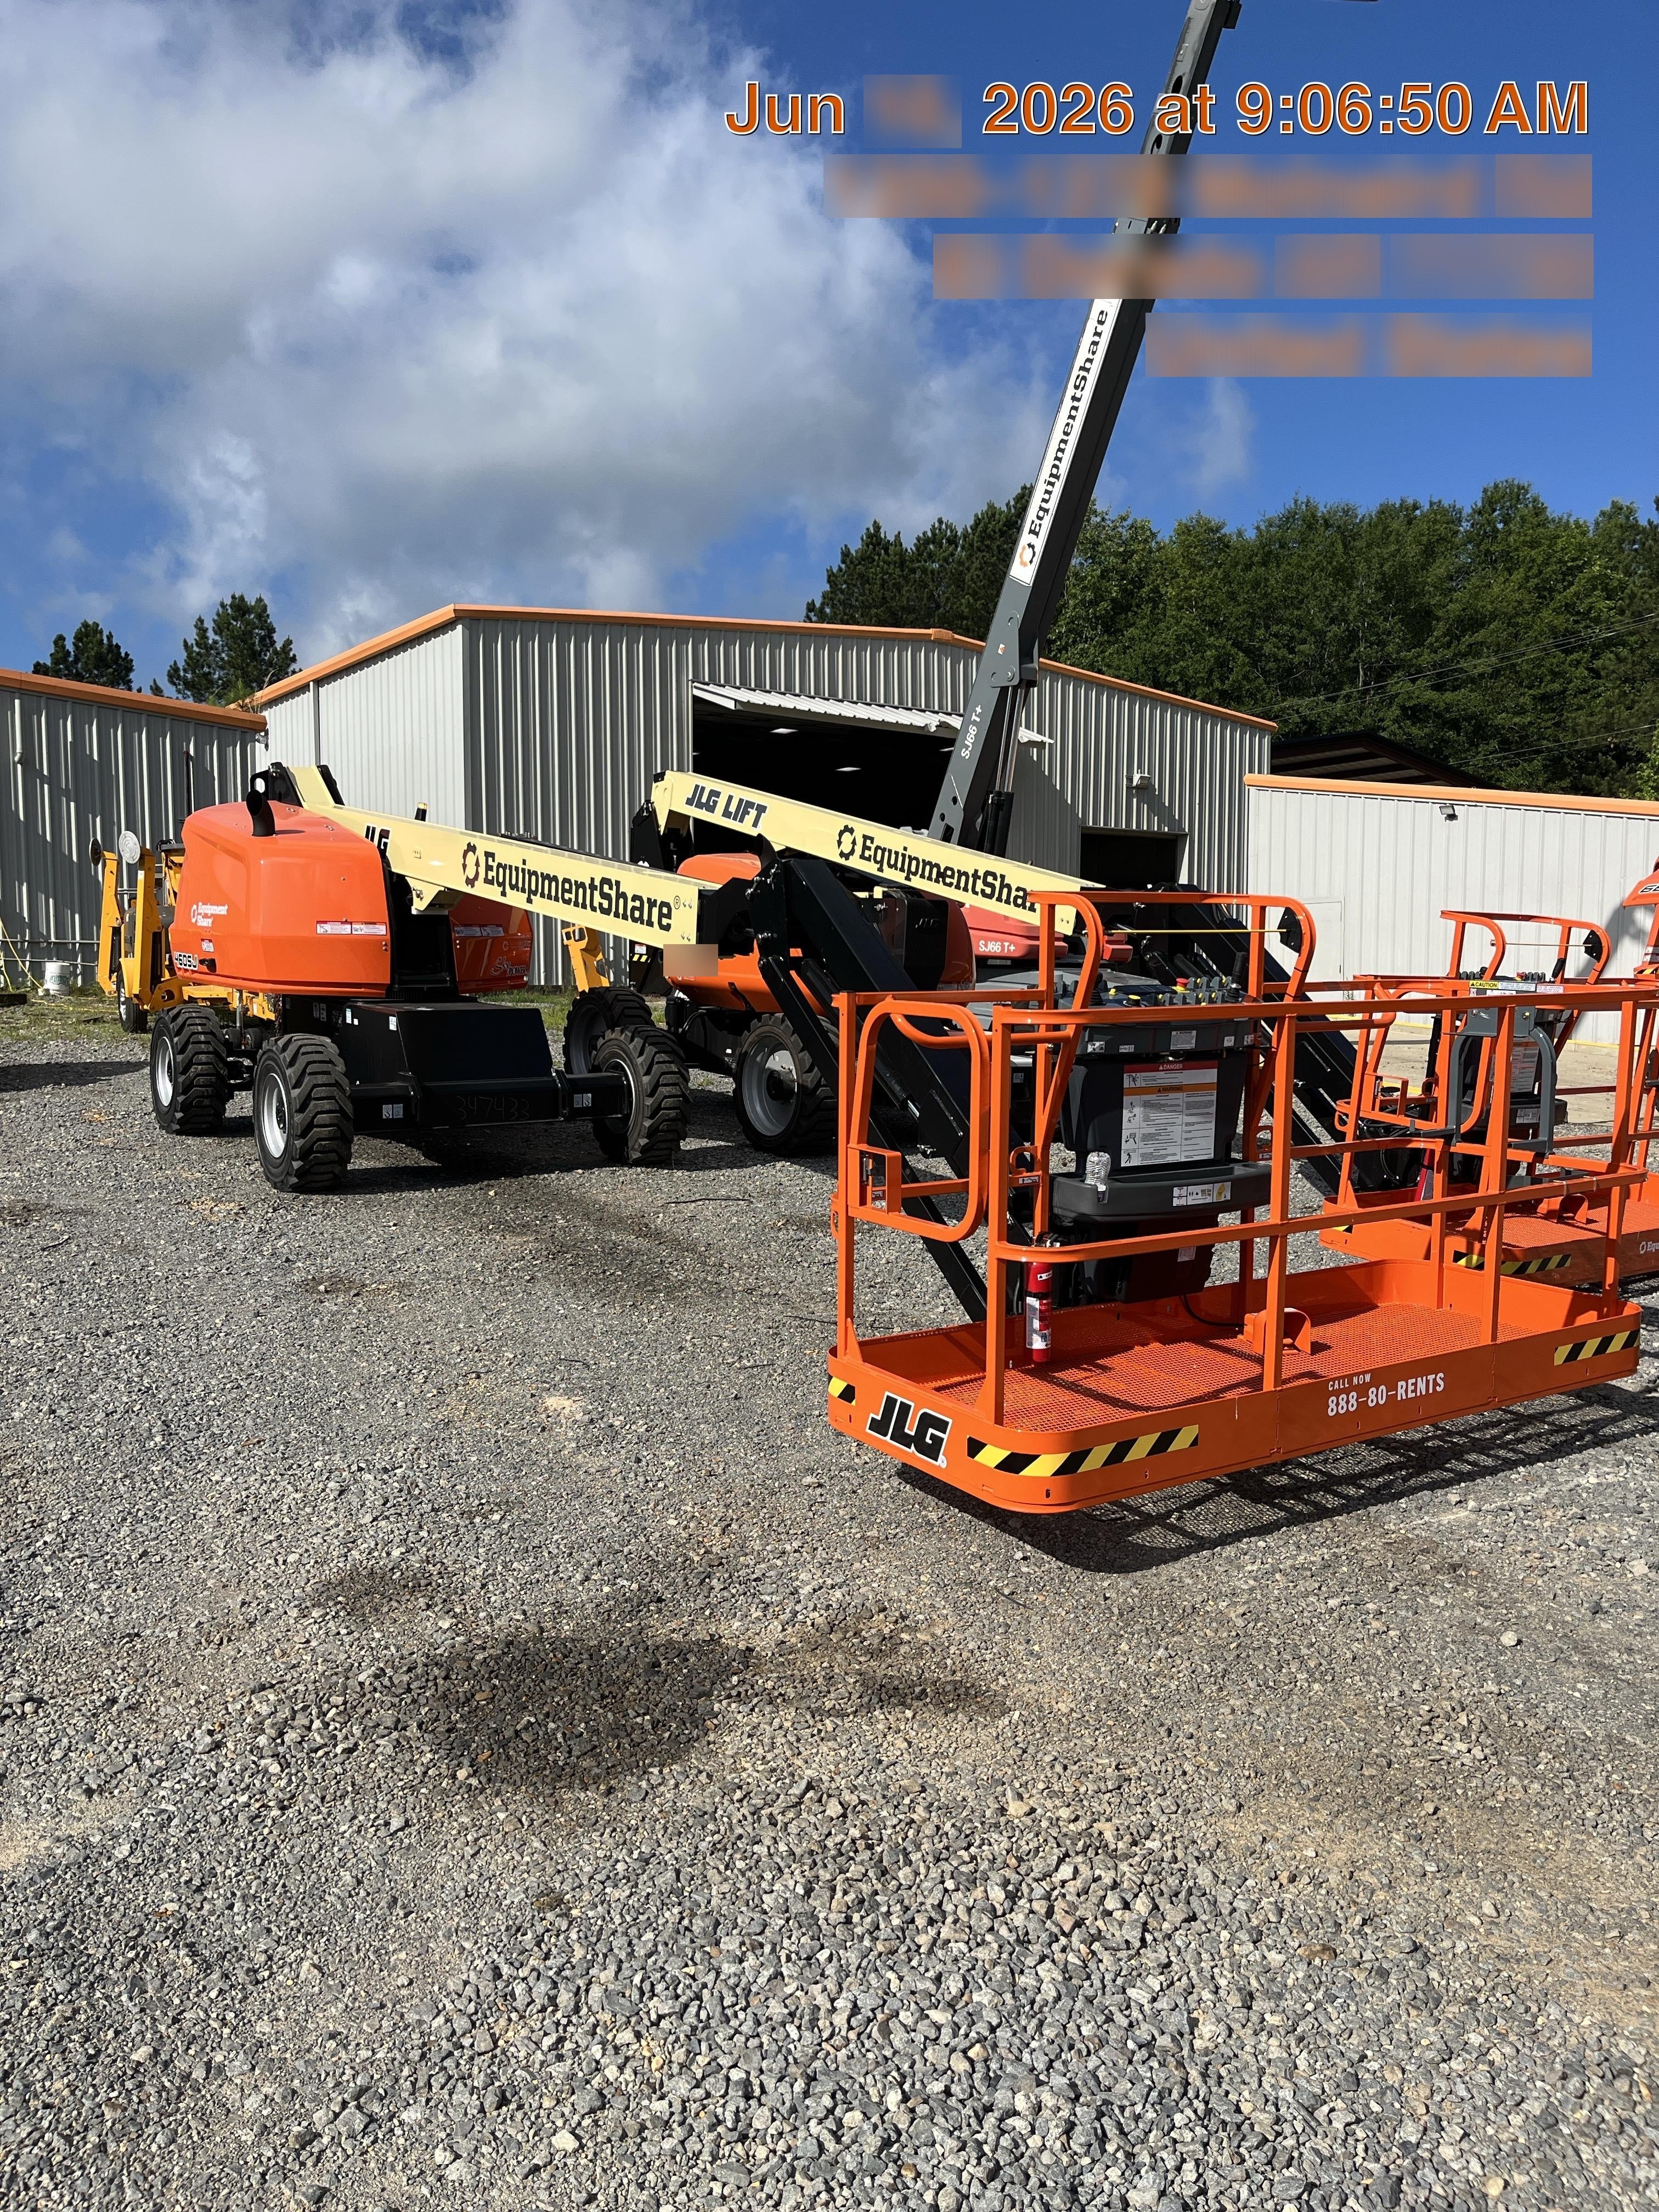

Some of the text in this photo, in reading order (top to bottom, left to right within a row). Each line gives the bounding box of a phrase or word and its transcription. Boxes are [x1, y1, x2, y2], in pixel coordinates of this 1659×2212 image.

[1028, 309, 1108, 539] EquipmentShare
[961, 724, 977, 759] SJ66
[685, 783, 768, 829] JLG LIFT
[483, 850, 673, 932] EquipmentShare
[859, 833, 1036, 913] EquipmentSha
[978, 940, 1016, 953] SJ66 T+
[456, 1096, 530, 1121] 347433
[1328, 1373, 1372, 1391] CALL NOW
[1328, 1372, 1444, 1417] 888-80-RENTS
[868, 1394, 950, 1463] JLG
